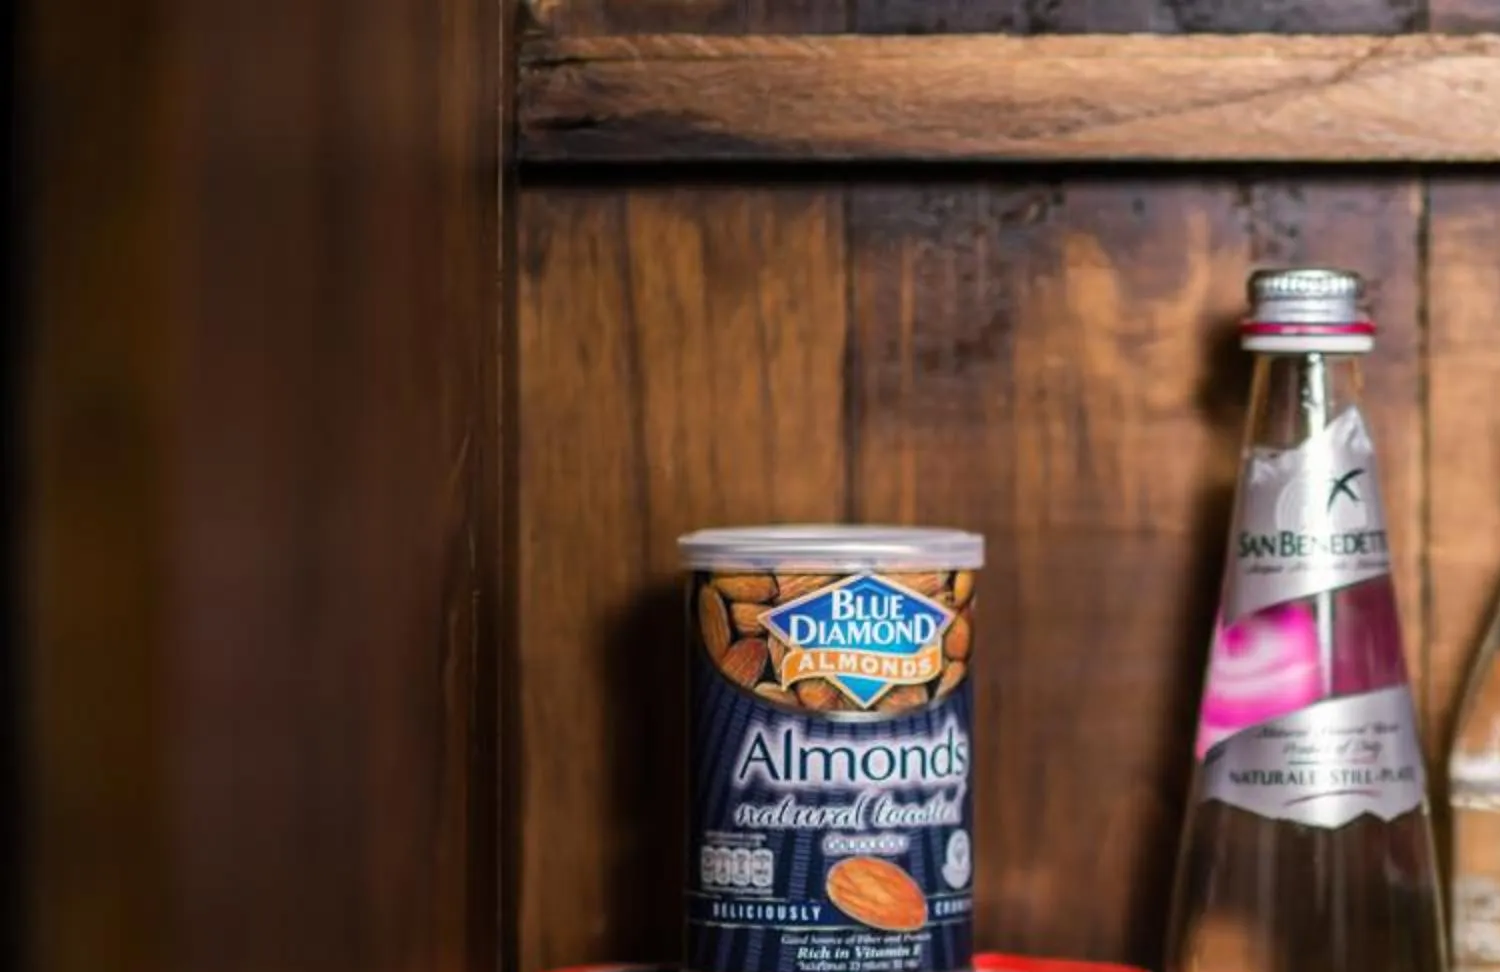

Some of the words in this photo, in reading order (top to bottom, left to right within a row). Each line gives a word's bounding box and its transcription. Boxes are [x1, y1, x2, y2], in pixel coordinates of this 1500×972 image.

[831, 589, 904, 621] BLUE
[788, 615, 937, 646] DIAMOND
[797, 653, 934, 679] ALMONDS
[738, 727, 967, 782] Almonds
[735, 791, 872, 831] natural
[712, 903, 822, 922] DELICIOUSLY
[797, 946, 831, 959] Rich
[834, 946, 849, 959] in
[855, 945, 910, 959] Vitamin
